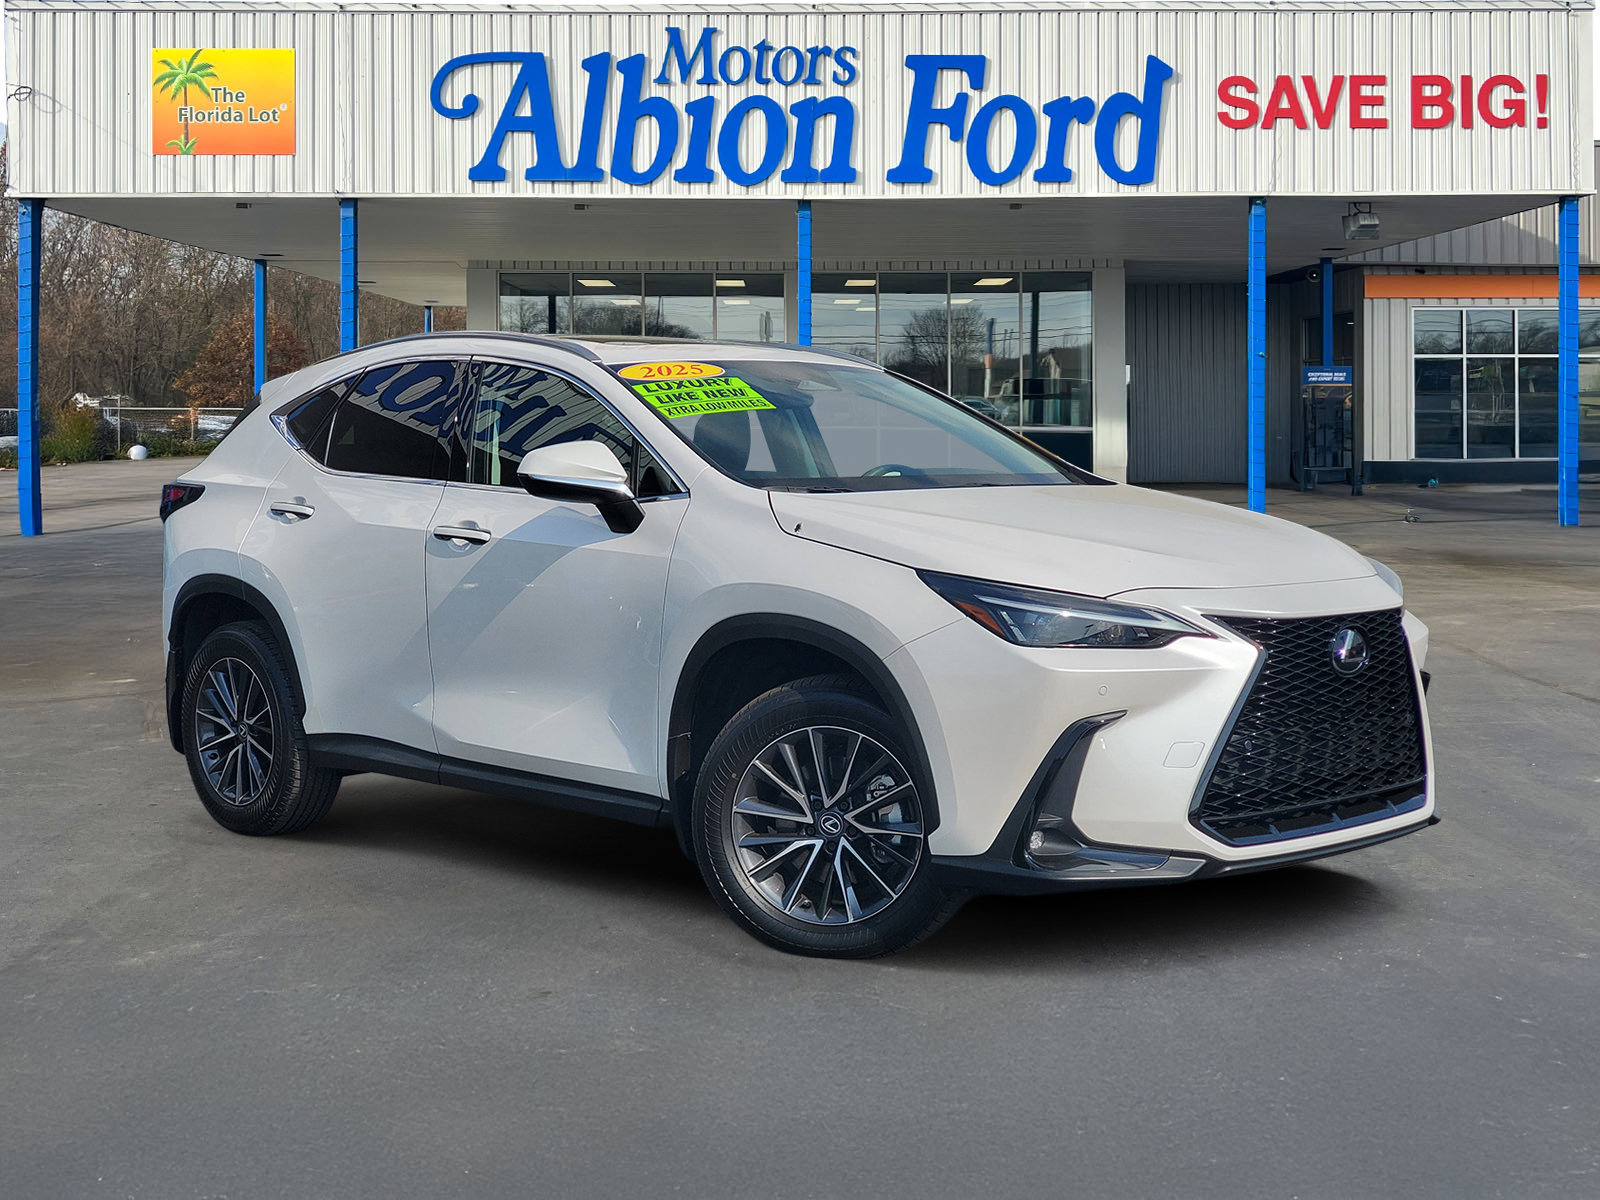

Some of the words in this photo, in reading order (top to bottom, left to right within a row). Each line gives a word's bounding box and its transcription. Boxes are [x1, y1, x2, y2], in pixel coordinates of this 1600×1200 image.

[653, 27, 857, 85] Motors
[211, 87, 245, 102] The
[1217, 75, 1388, 129] SAVE
[1411, 74, 1548, 129] BIG!
[178, 106, 243, 122] Florida
[430, 52, 857, 186] Albion
[886, 55, 1173, 186] Ford
[639, 364, 704, 379] 2025
[642, 377, 733, 394] LUXURY
[655, 391, 700, 405] LIKE
[705, 387, 747, 399] NEW
[663, 403, 700, 416] XTRA
[727, 398, 768, 409] MILES
